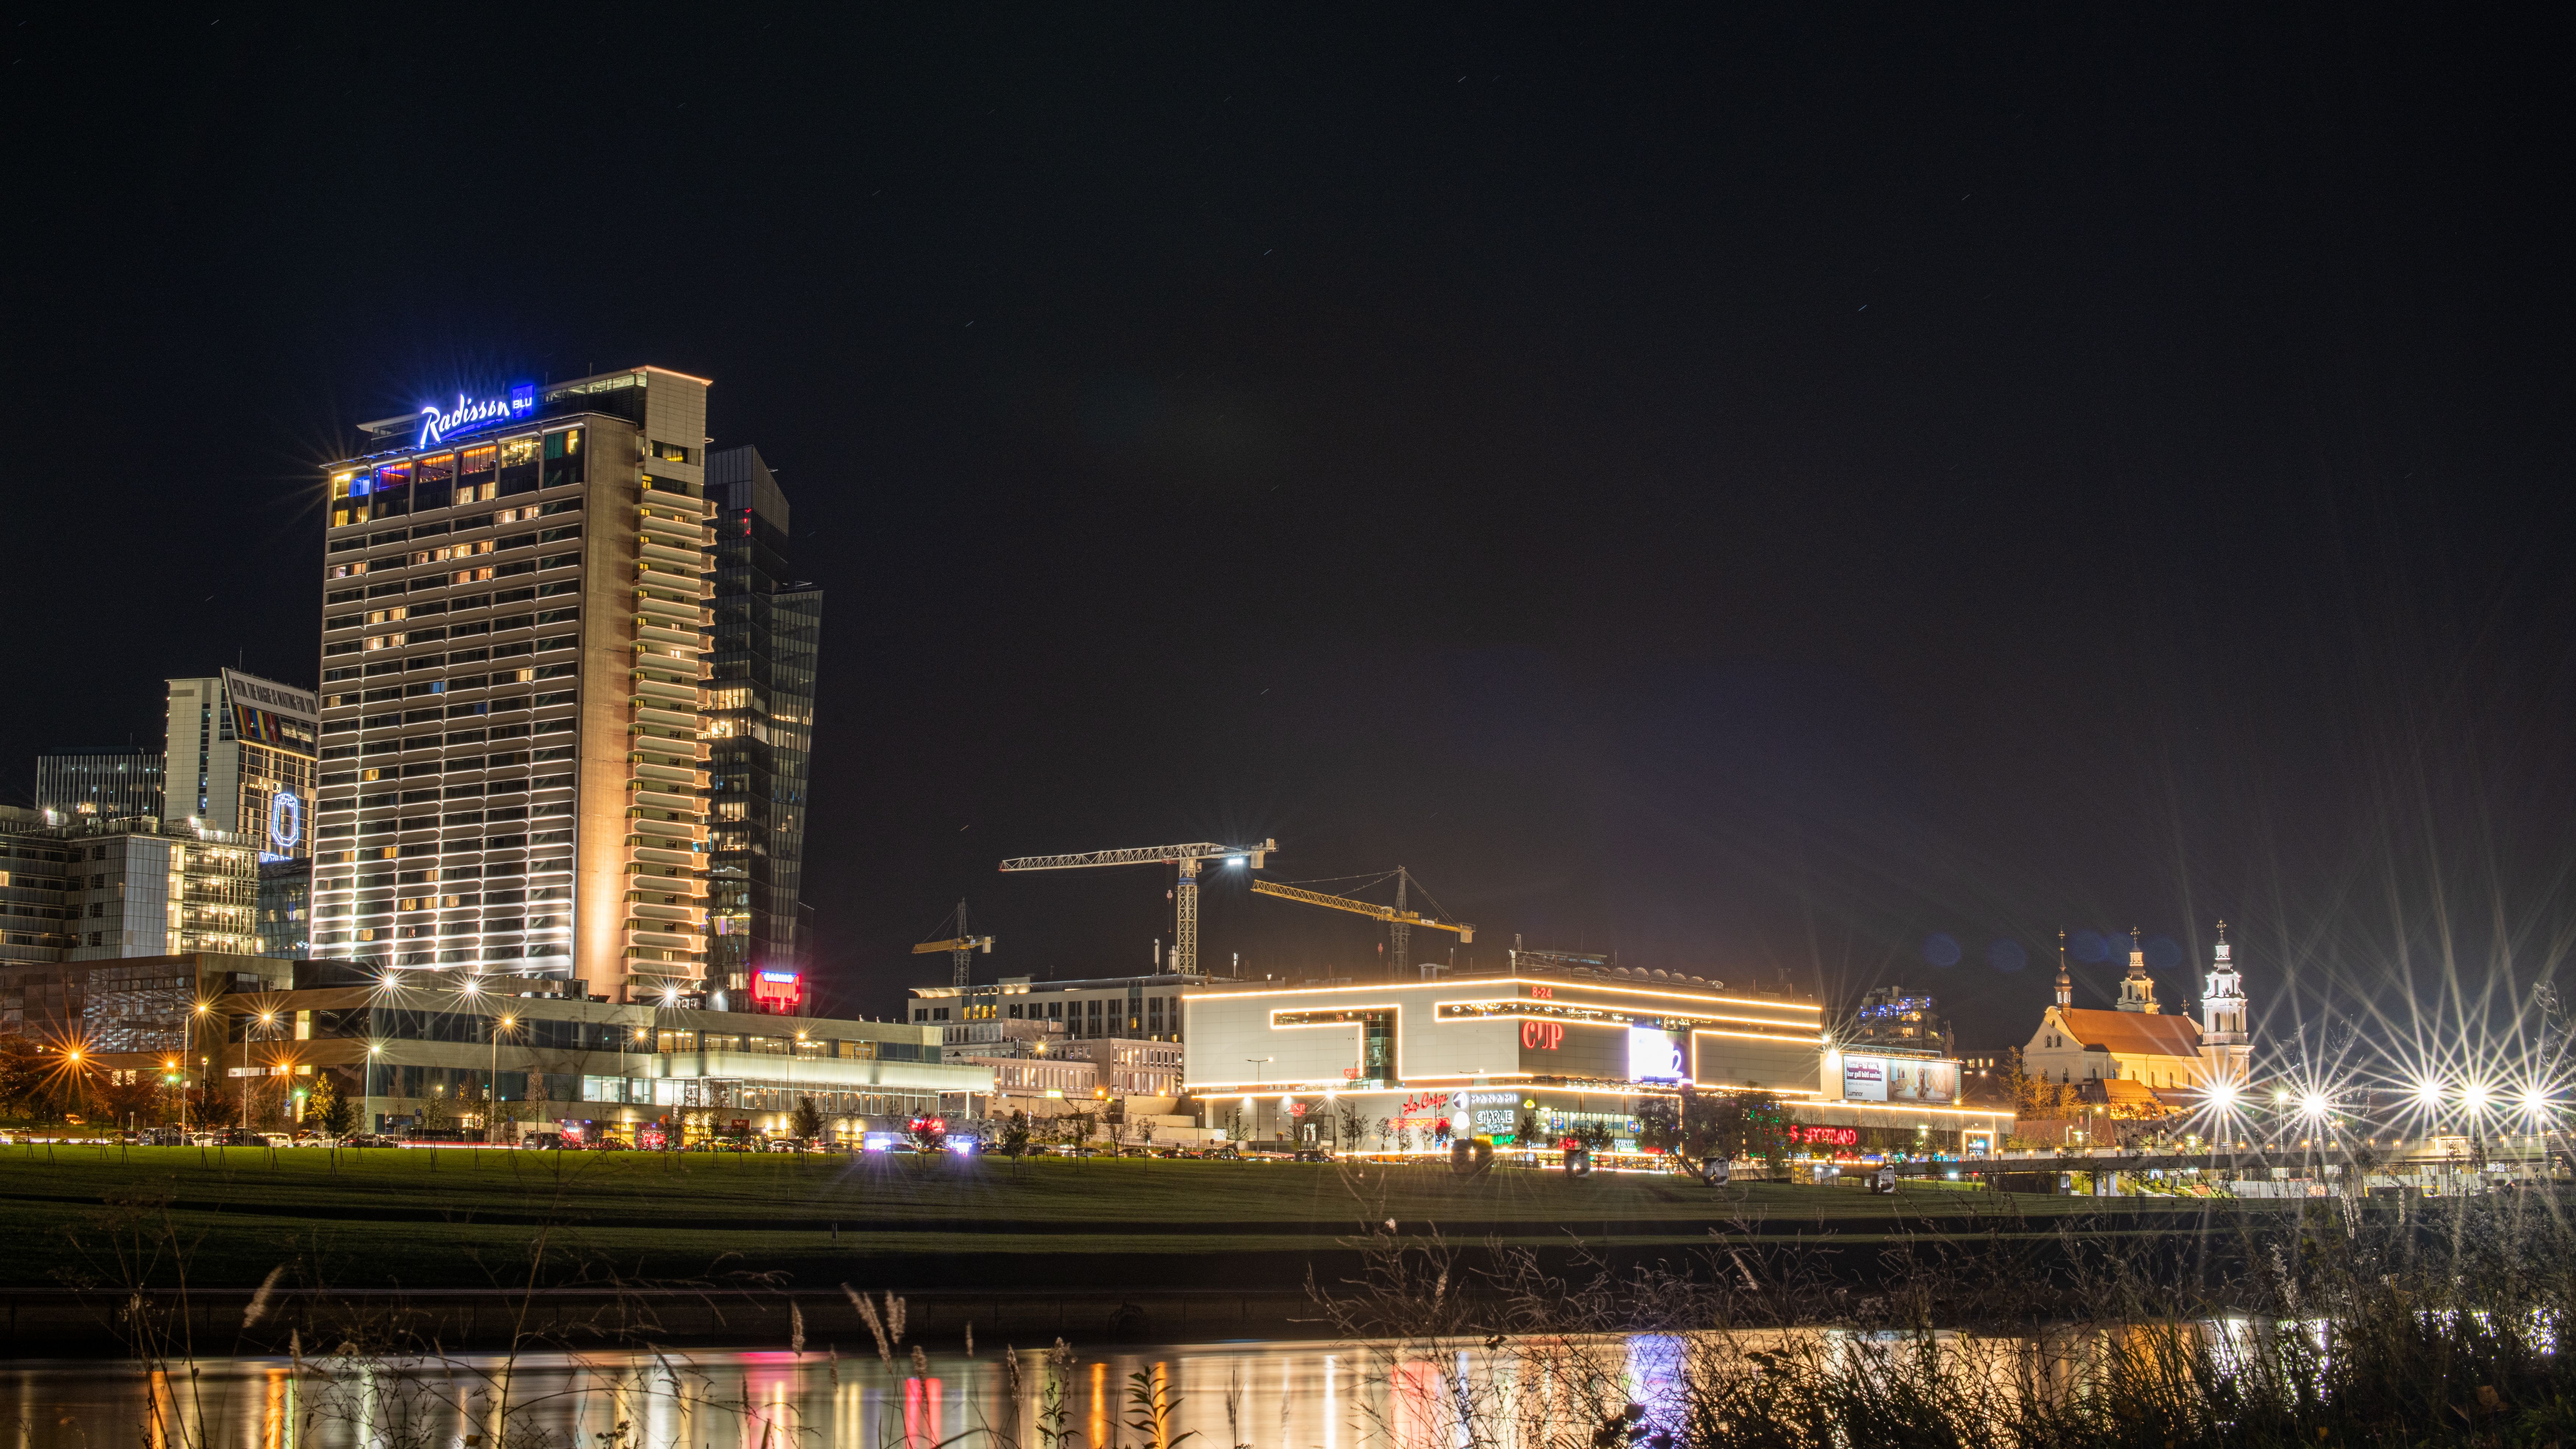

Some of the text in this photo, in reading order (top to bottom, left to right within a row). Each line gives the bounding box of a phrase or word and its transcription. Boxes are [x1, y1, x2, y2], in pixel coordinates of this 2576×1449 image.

[420, 394, 532, 449] Radisson BLU
[231, 678, 316, 715] PUTIN, THE HAGUE IS WAITING FOR YOU
[755, 973, 799, 1010] OLYMPIC
[1522, 1021, 1563, 1049] CUP
[1402, 1094, 1419, 1116] La
[1471, 1095, 1517, 1103] MANAMI
[1476, 1110, 1514, 1123] CHARLIE
